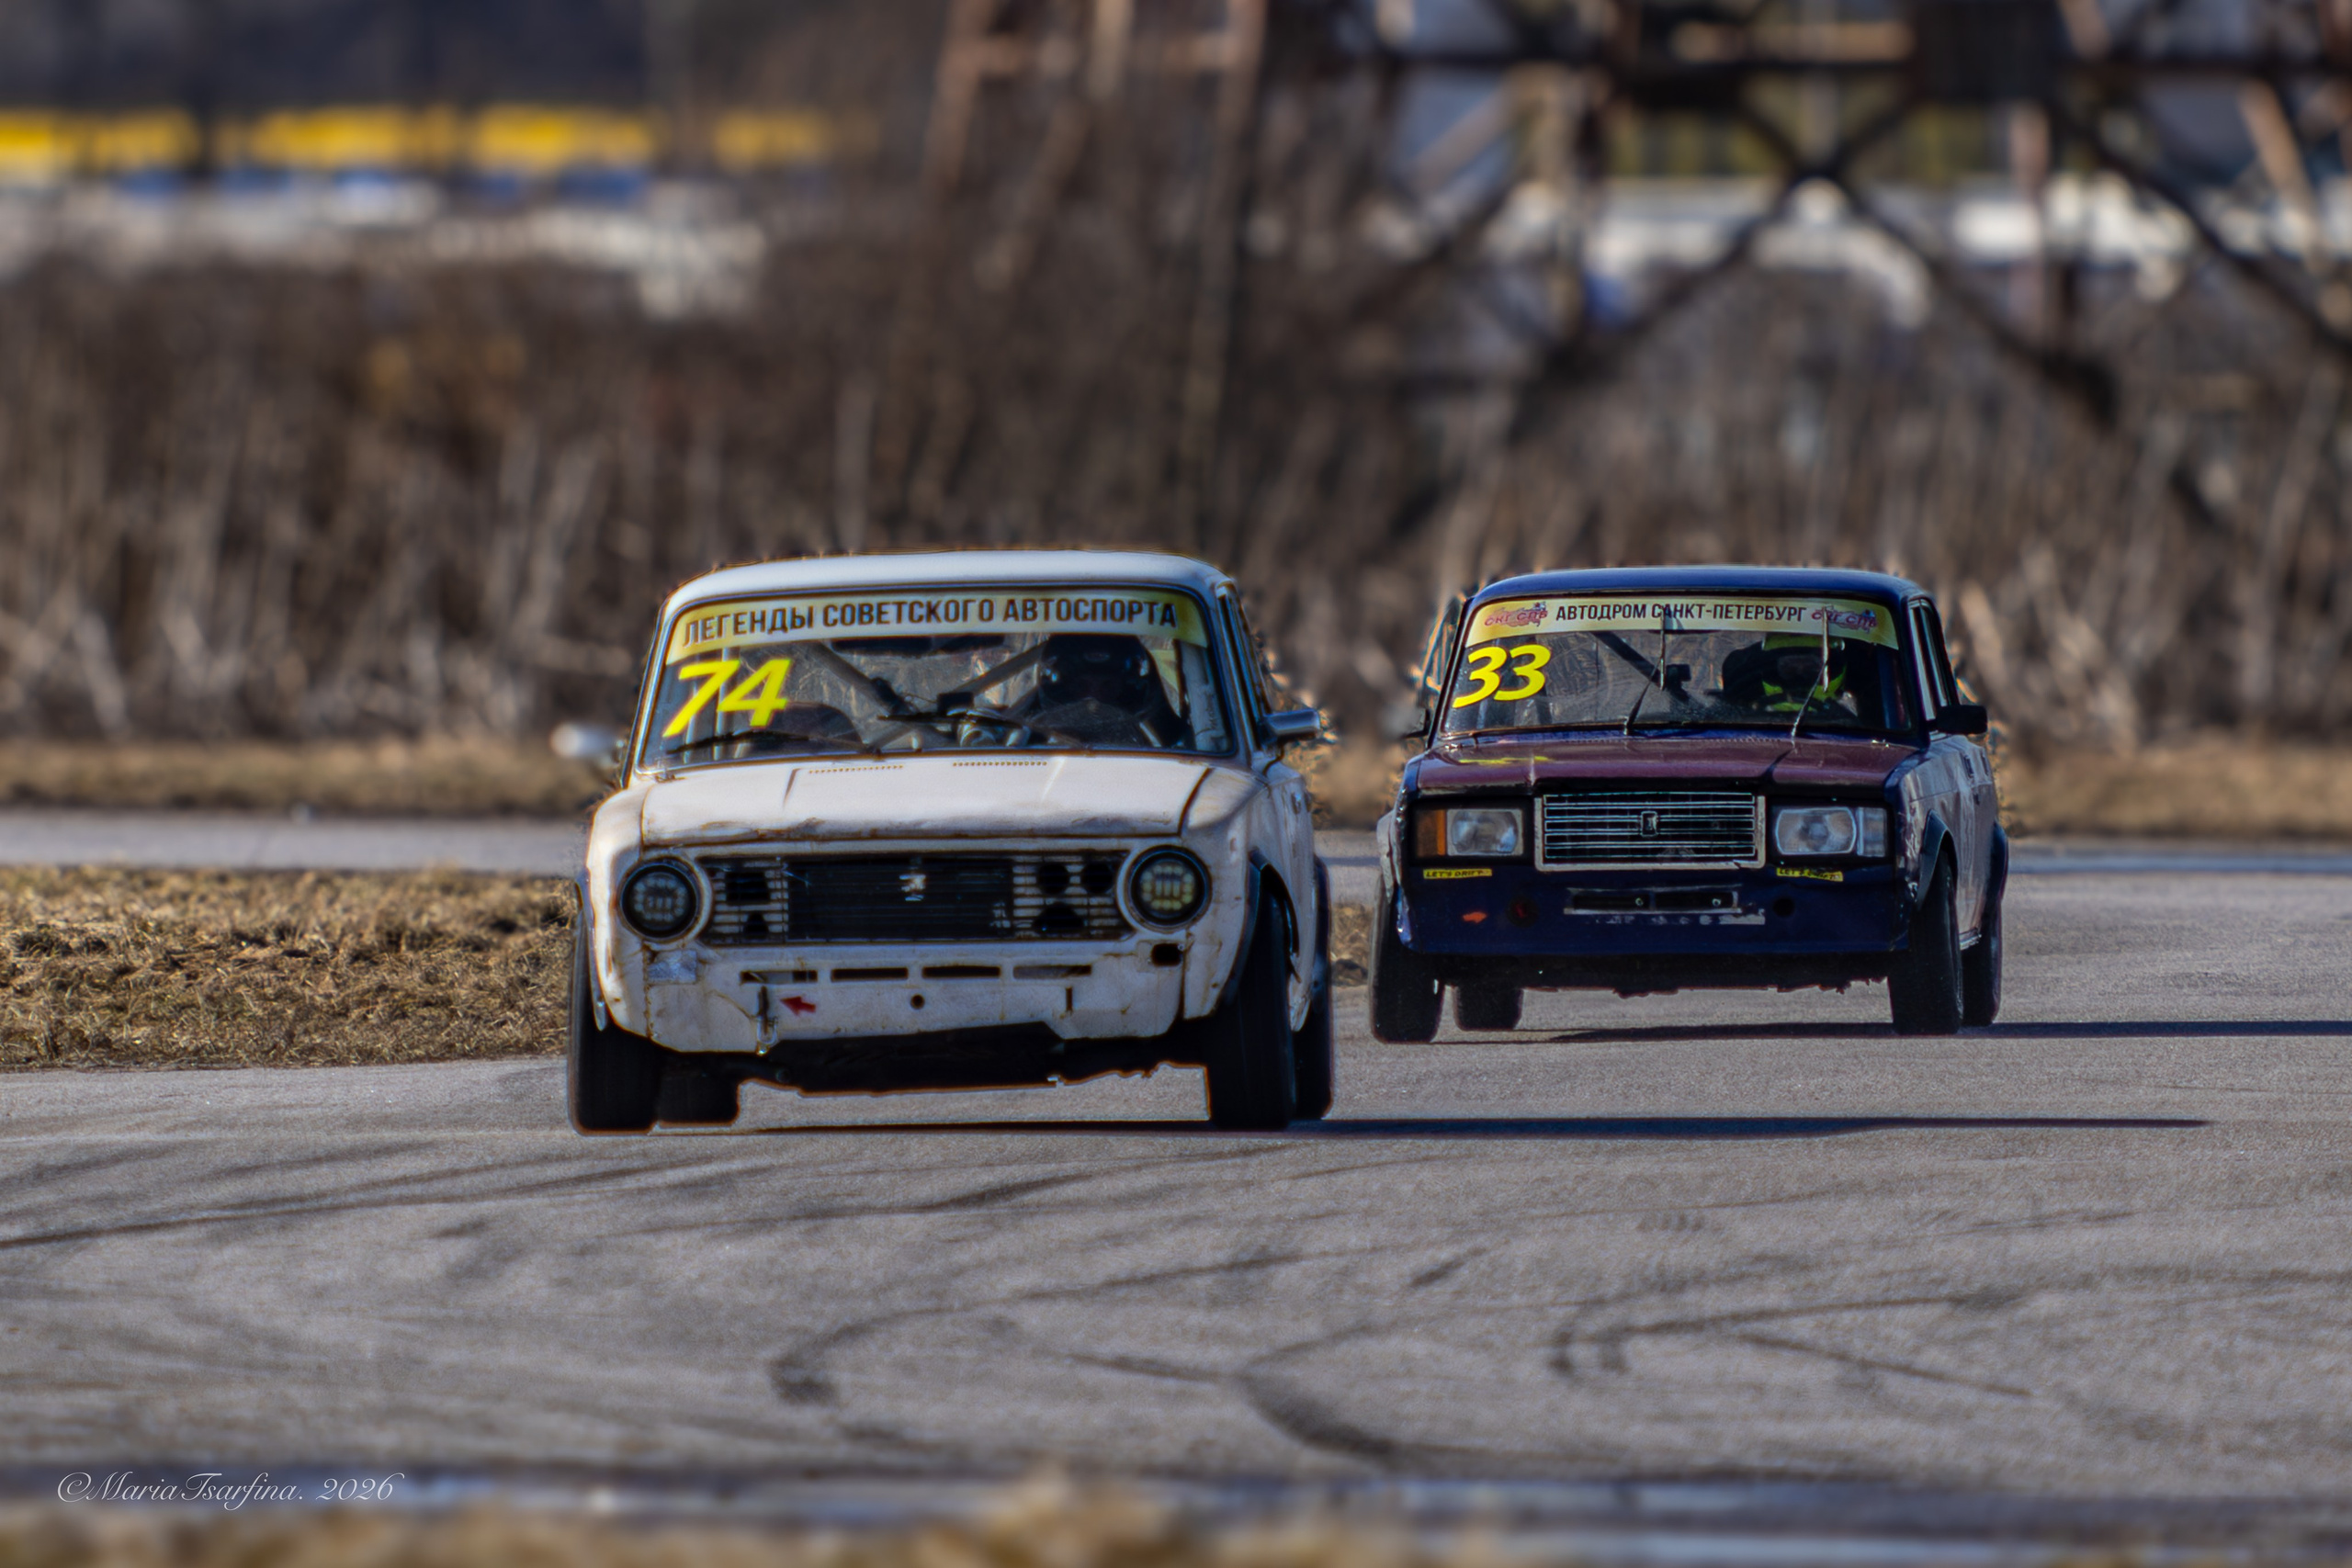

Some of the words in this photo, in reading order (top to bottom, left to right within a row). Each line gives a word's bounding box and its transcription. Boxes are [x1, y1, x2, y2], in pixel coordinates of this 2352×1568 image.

[684, 605, 814, 648] ЛЕГЕНДЫ
[822, 599, 995, 628] СОВЕТСКОГО
[1002, 598, 1177, 628] АВТОСПОРТА
[1555, 604, 1646, 622] АВТОДРОМ
[1651, 603, 1807, 623] САНКТ-ПЕТЕРБУРГ
[662, 658, 793, 738] 74
[1452, 644, 1551, 709] 33
